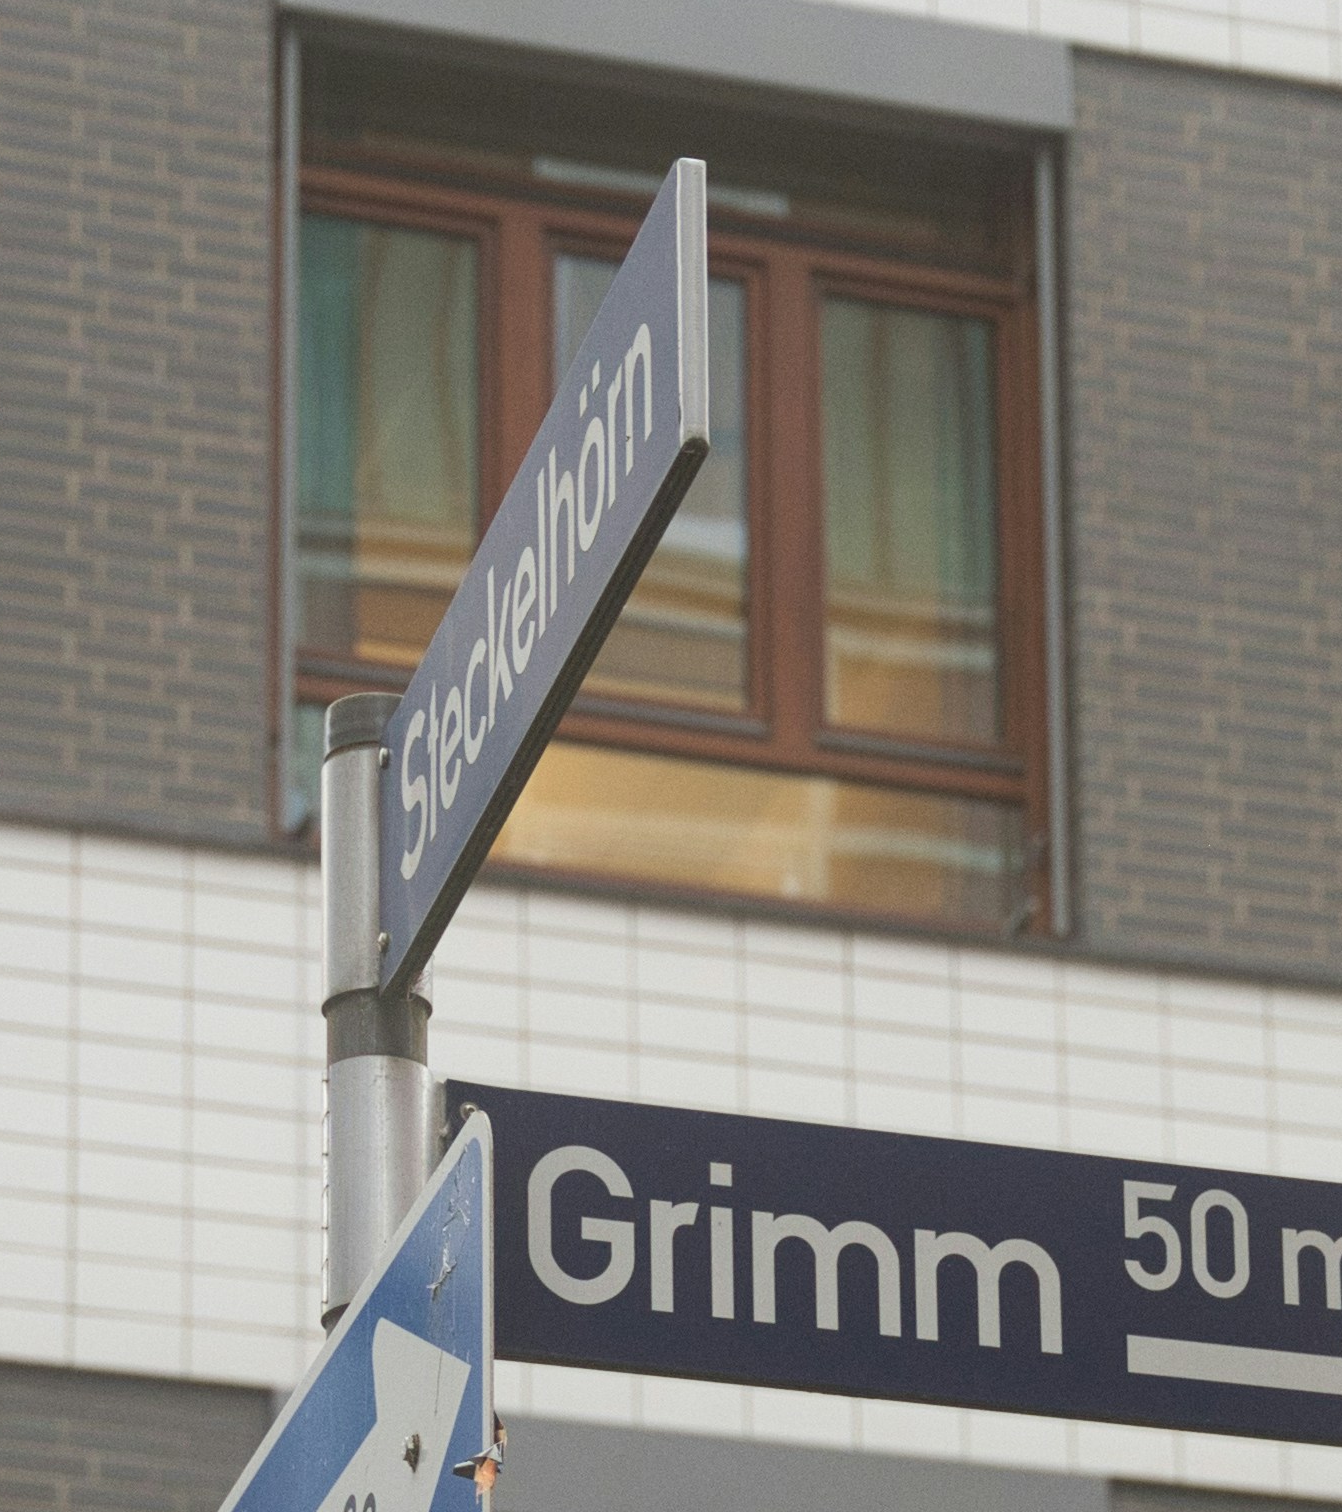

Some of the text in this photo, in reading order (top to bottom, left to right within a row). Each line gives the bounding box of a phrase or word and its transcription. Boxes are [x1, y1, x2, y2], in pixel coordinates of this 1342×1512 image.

[400, 322, 653, 881] Steckelhörn
[527, 1144, 1064, 1355] Grimm
[1122, 1179, 1251, 1299] 50
